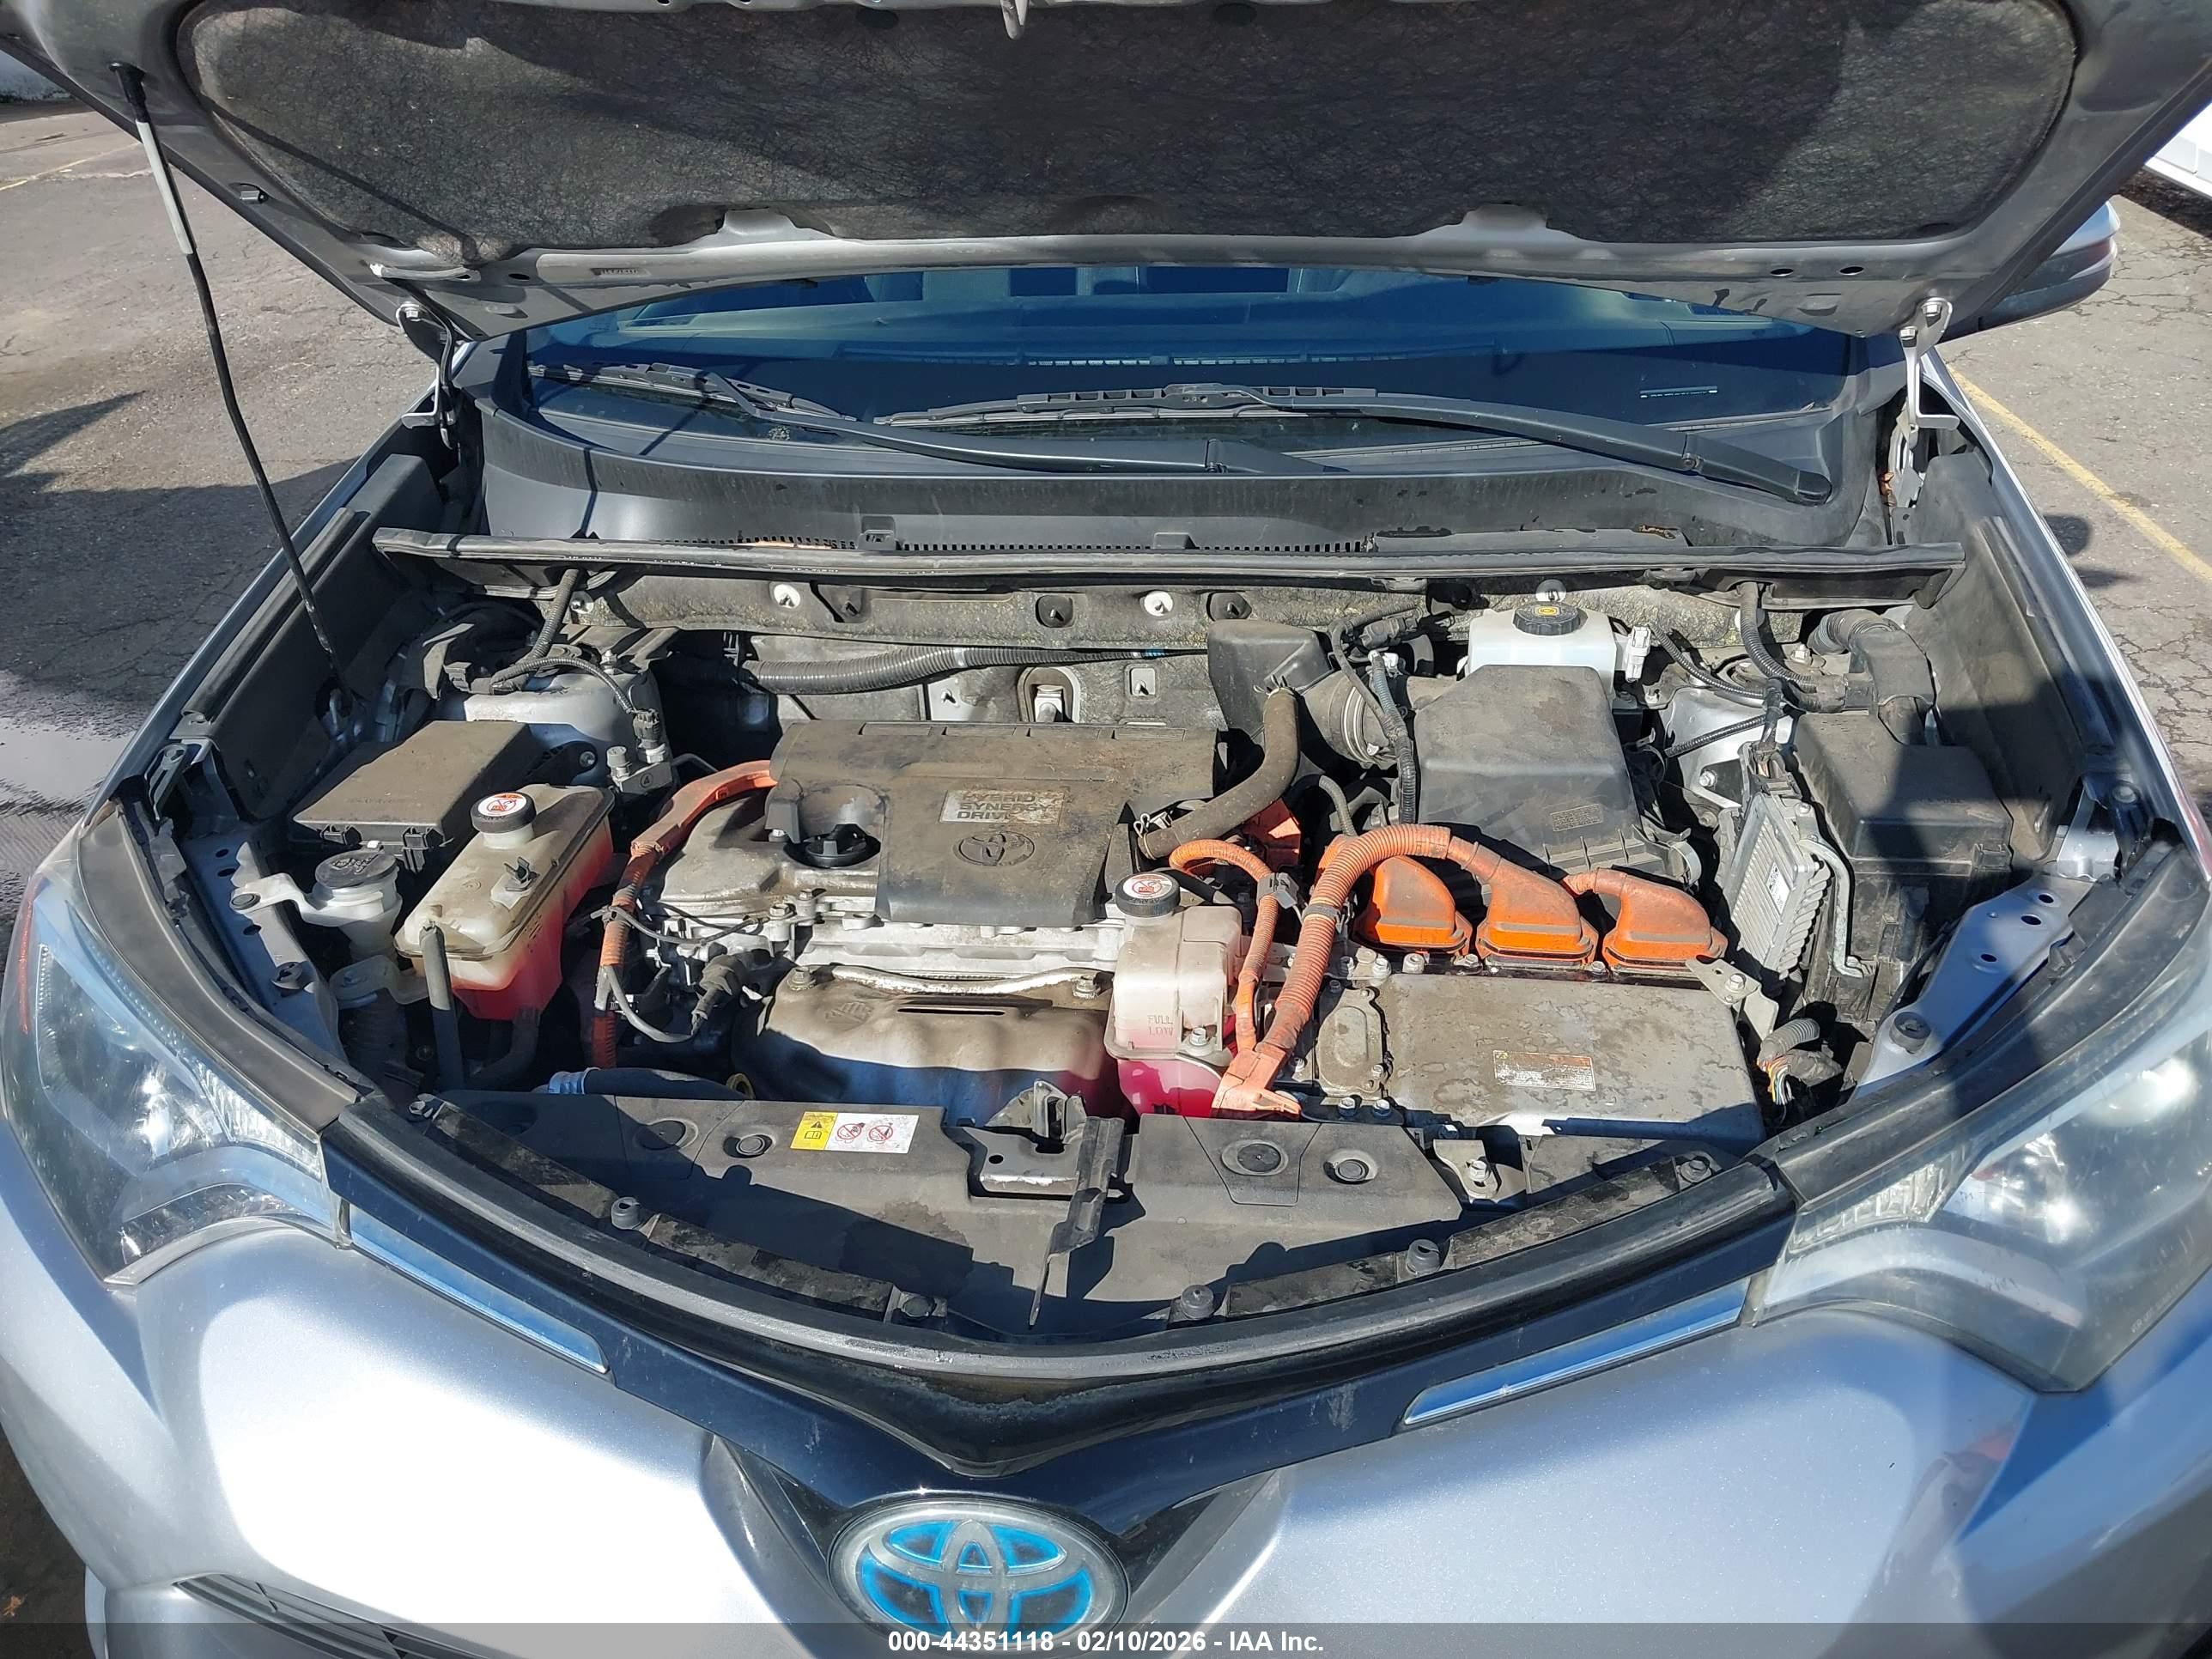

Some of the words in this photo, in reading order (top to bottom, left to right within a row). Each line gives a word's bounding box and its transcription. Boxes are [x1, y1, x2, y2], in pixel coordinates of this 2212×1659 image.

[959, 802, 1051, 811] SYNERGY
[1147, 1014, 1174, 1024] FULL
[1148, 1026, 1174, 1036] LOW
